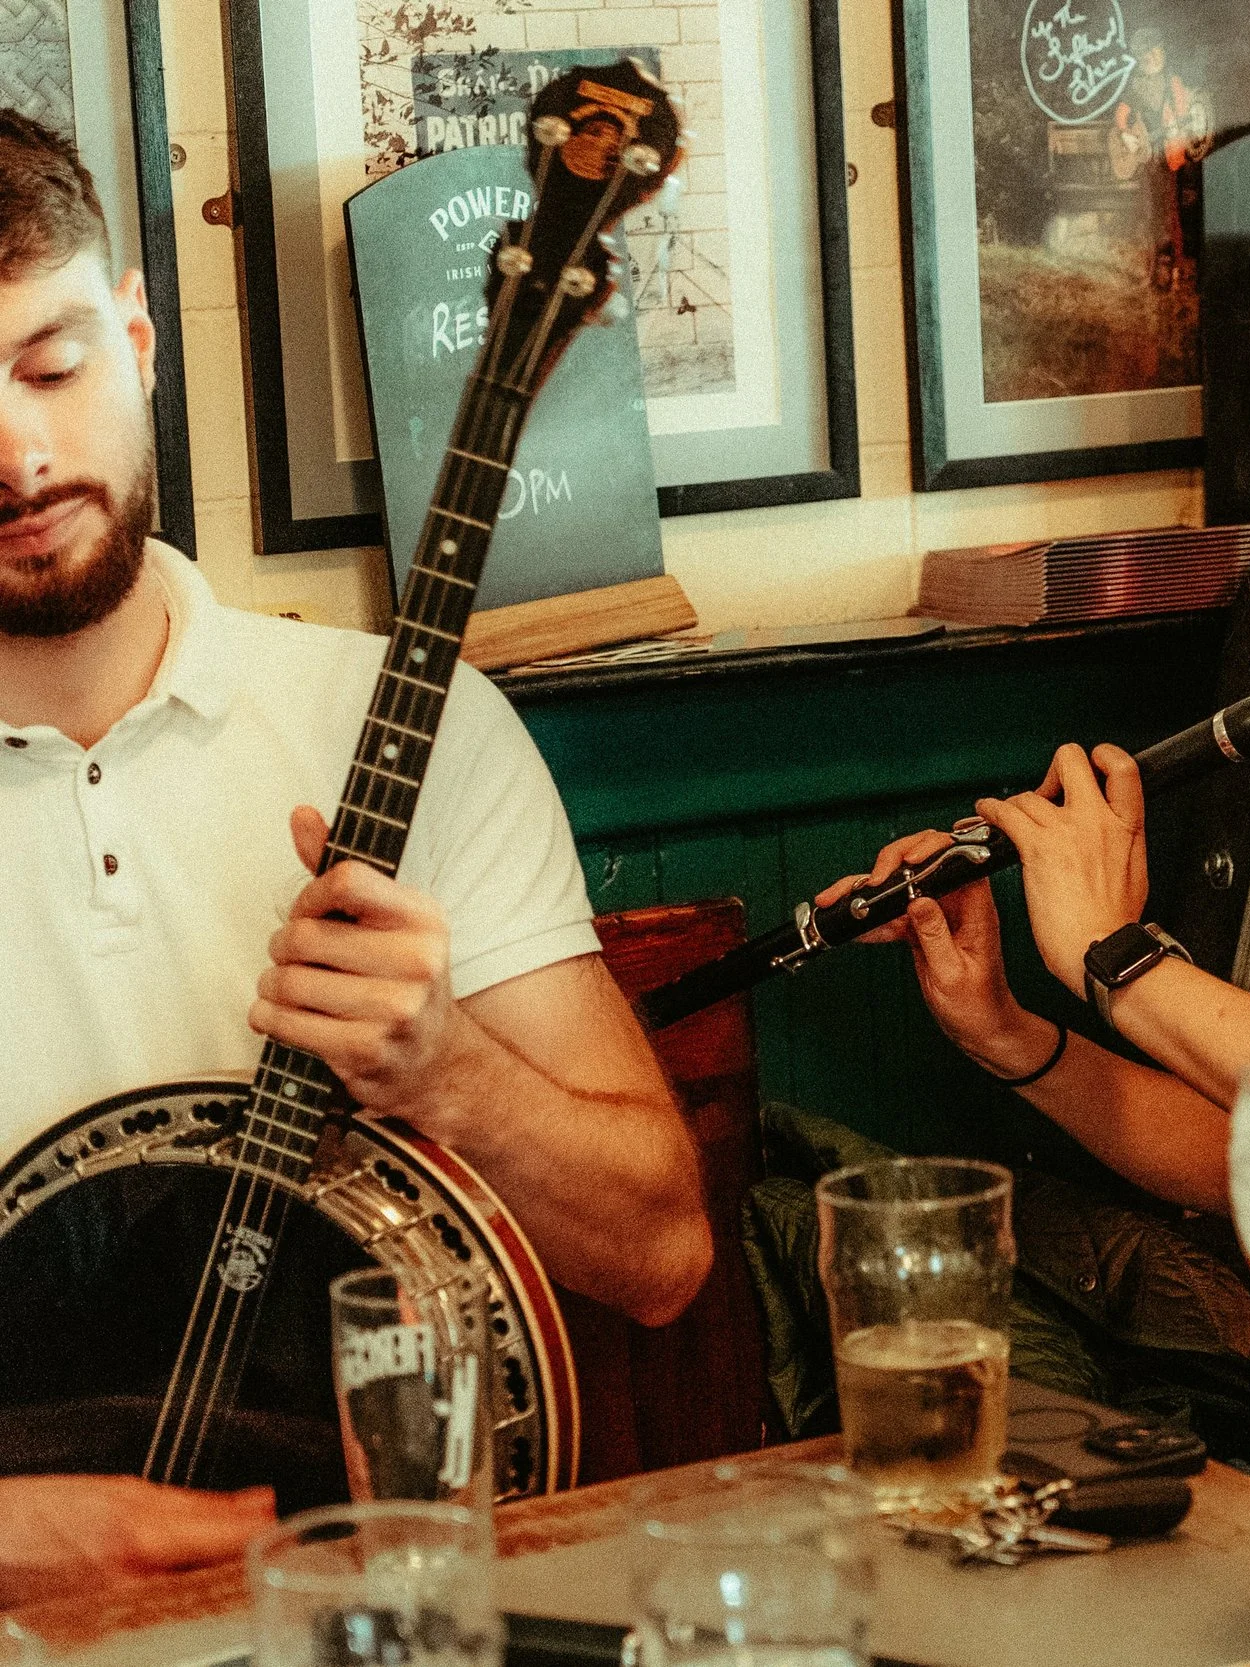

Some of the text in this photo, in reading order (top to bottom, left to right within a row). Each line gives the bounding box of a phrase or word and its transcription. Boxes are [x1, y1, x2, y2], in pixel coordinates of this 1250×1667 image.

[427, 111, 529, 153] PATRIC
[429, 186, 540, 241] POWER
[446, 266, 482, 281] IRISH
